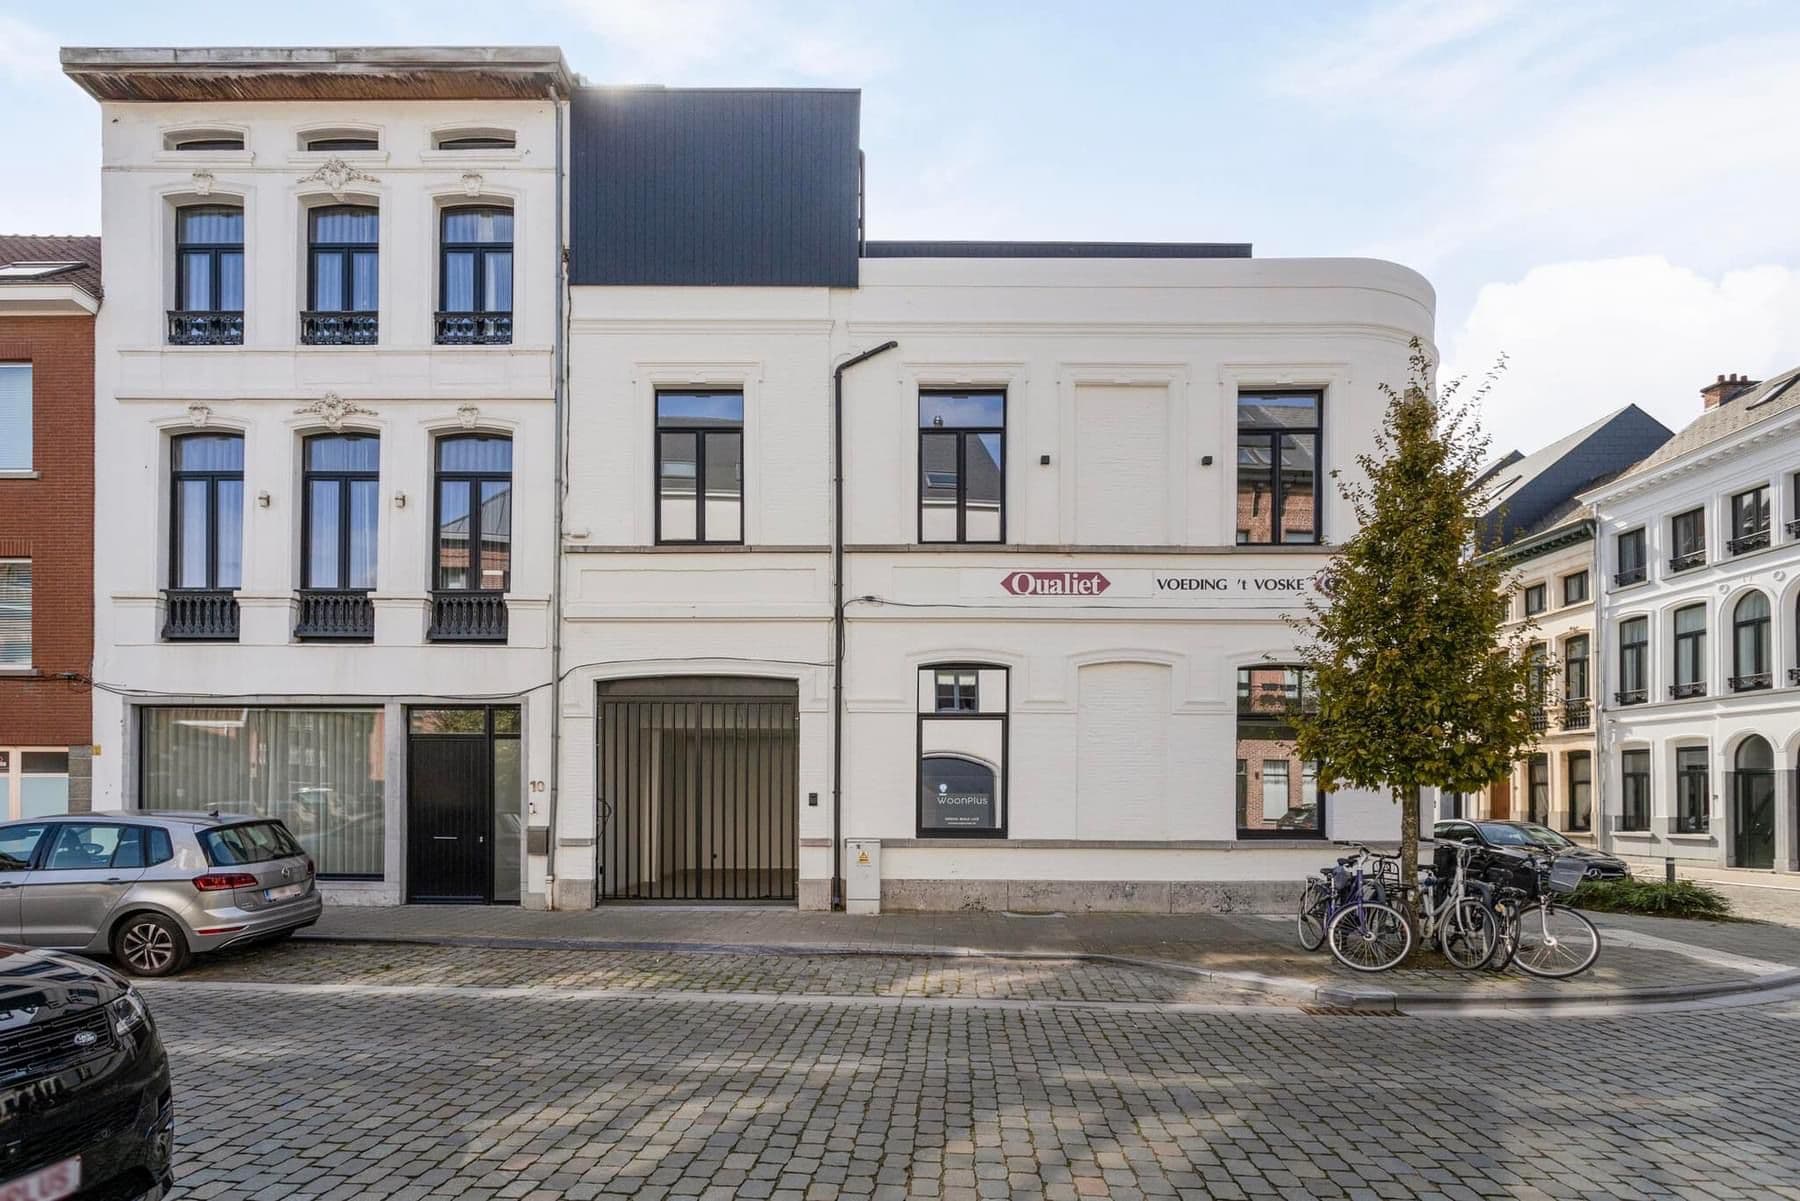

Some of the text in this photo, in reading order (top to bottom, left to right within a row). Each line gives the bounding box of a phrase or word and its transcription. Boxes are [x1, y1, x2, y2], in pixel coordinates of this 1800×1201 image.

[1011, 573, 1100, 595] Qualiet
[1157, 578, 1227, 591] VOEDING
[1254, 578, 1304, 591] VOSKE
[529, 780, 544, 793] 10
[937, 796, 988, 805] WoonPlus
